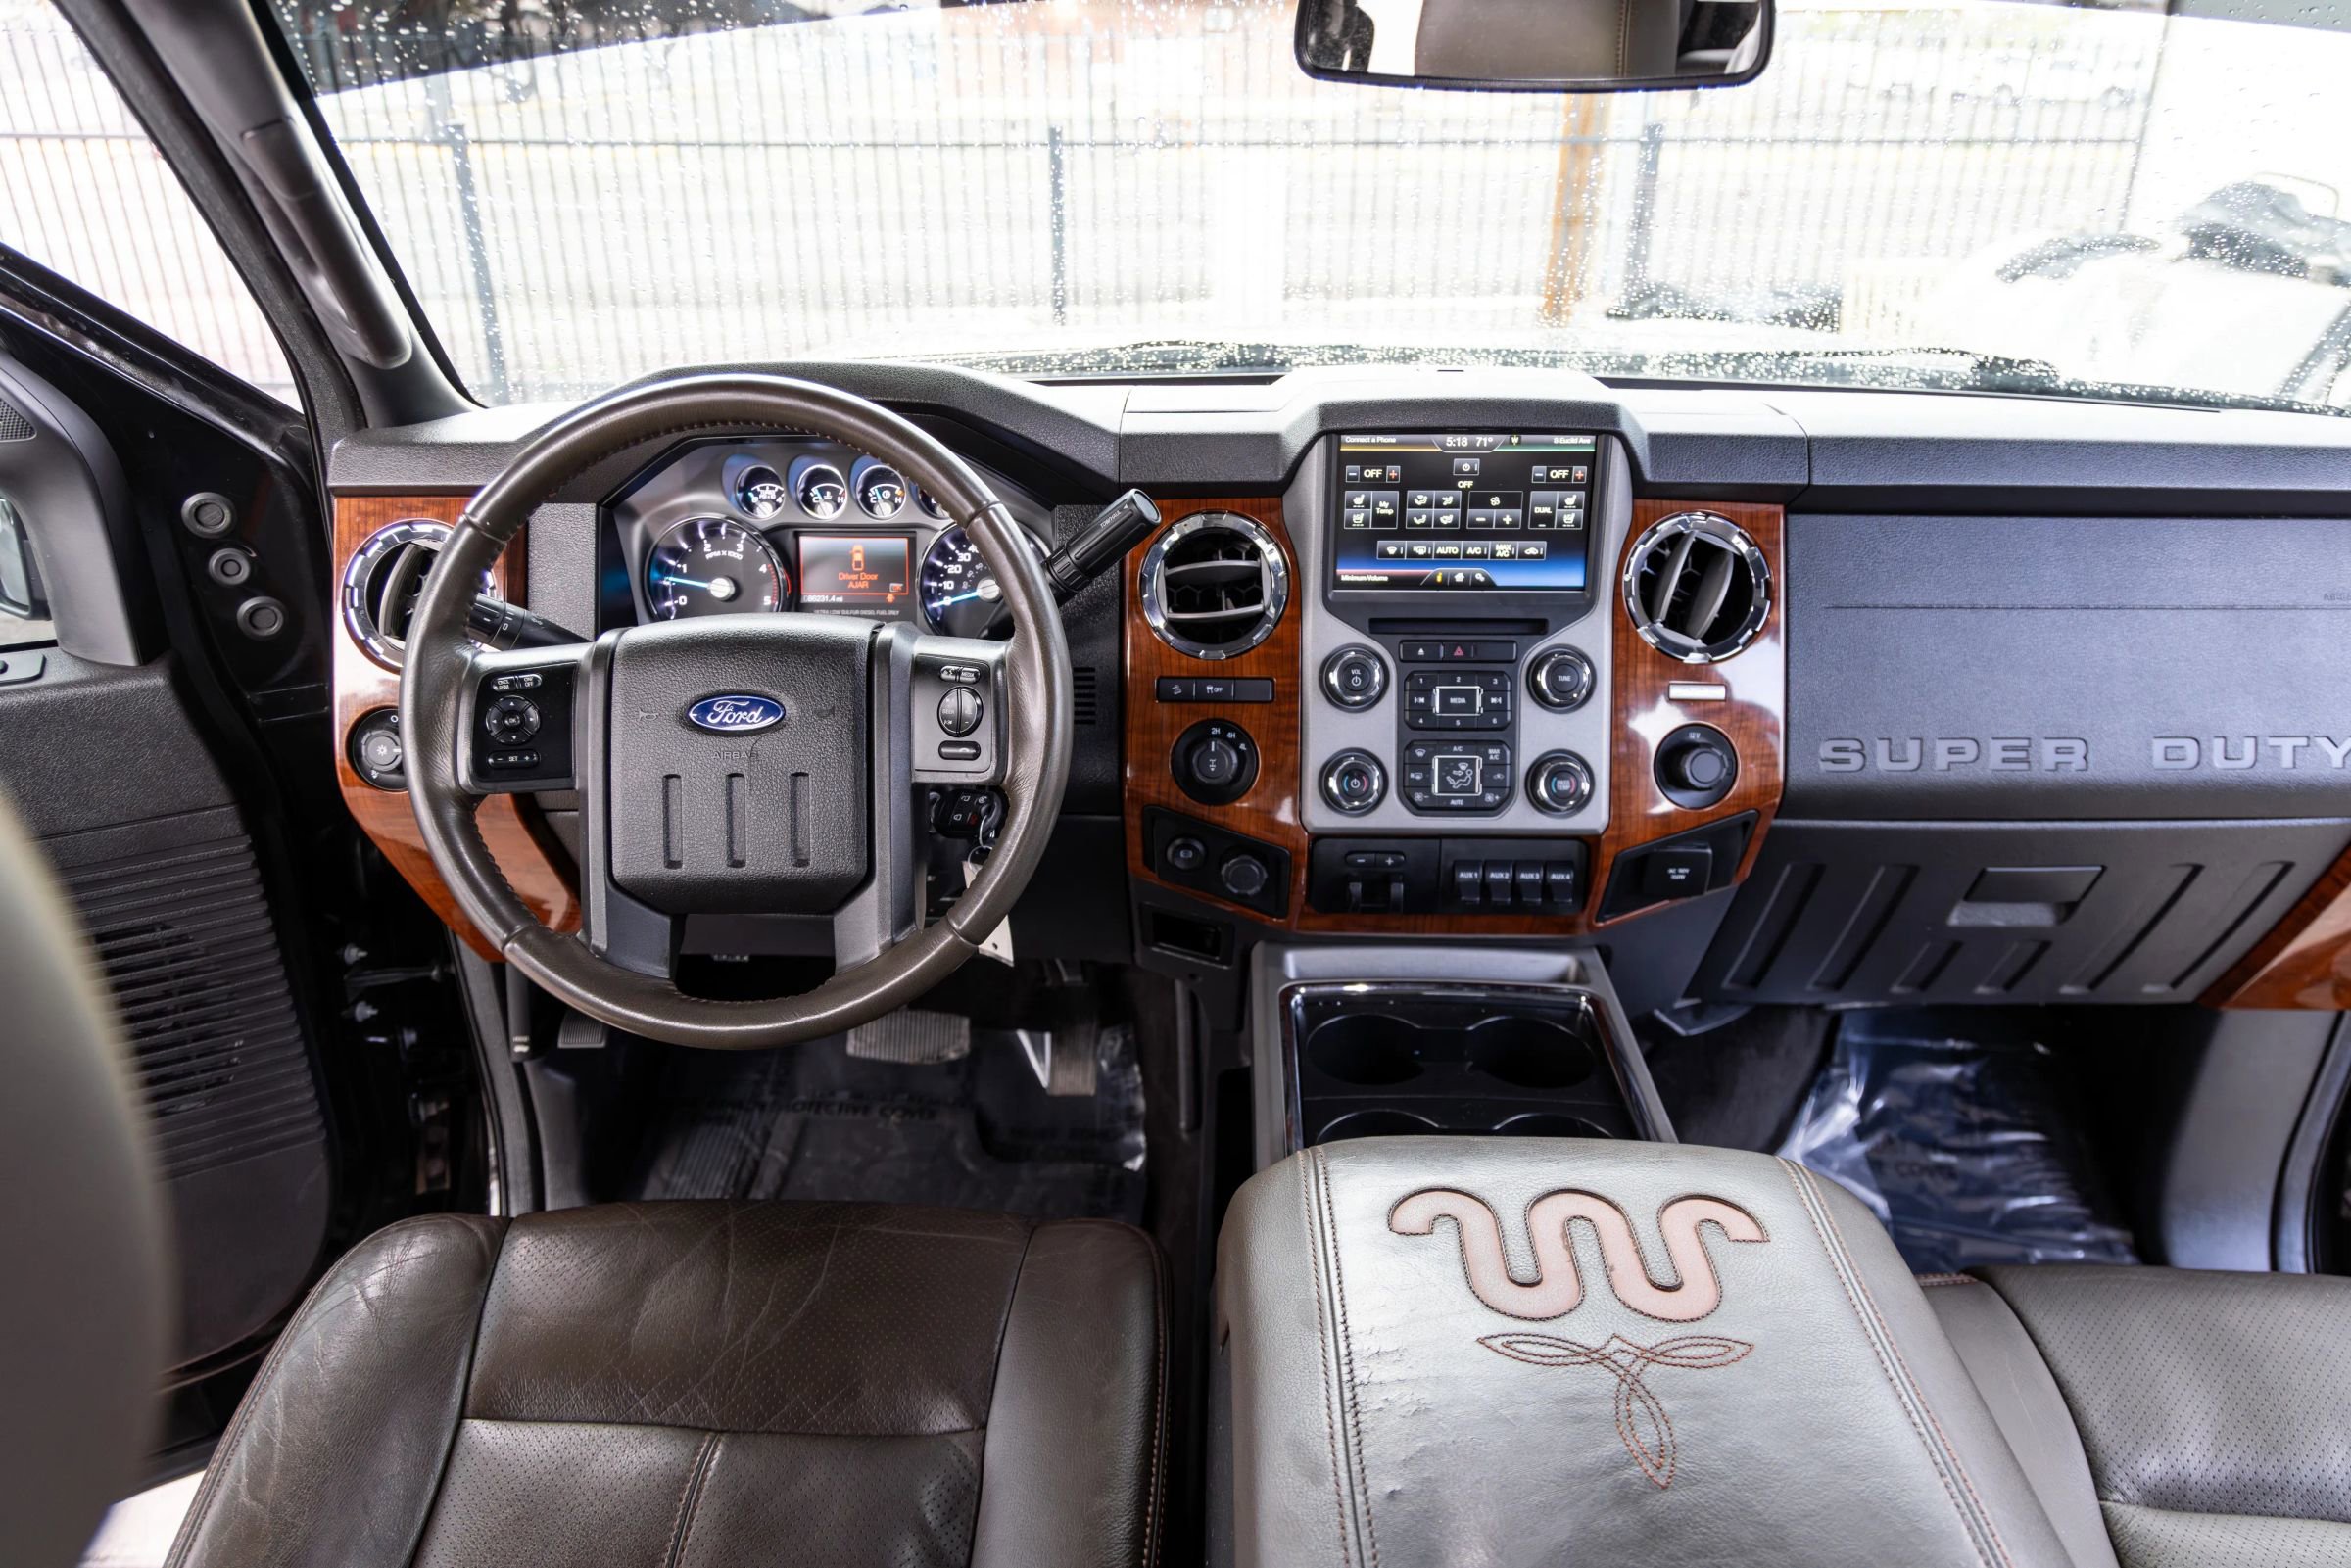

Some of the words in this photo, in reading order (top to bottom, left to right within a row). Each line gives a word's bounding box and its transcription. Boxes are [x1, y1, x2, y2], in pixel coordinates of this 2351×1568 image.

[1446, 437, 1468, 447] 5:18
[1364, 469, 1382, 478] OFF
[1550, 470, 1569, 479] OFF
[957, 552, 971, 561] 30
[758, 564, 767, 573] 4
[947, 564, 962, 574] 20
[942, 581, 955, 590] 10
[764, 596, 772, 605] 5
[706, 700, 764, 724] Ford
[1819, 737, 2089, 772] SUPER
